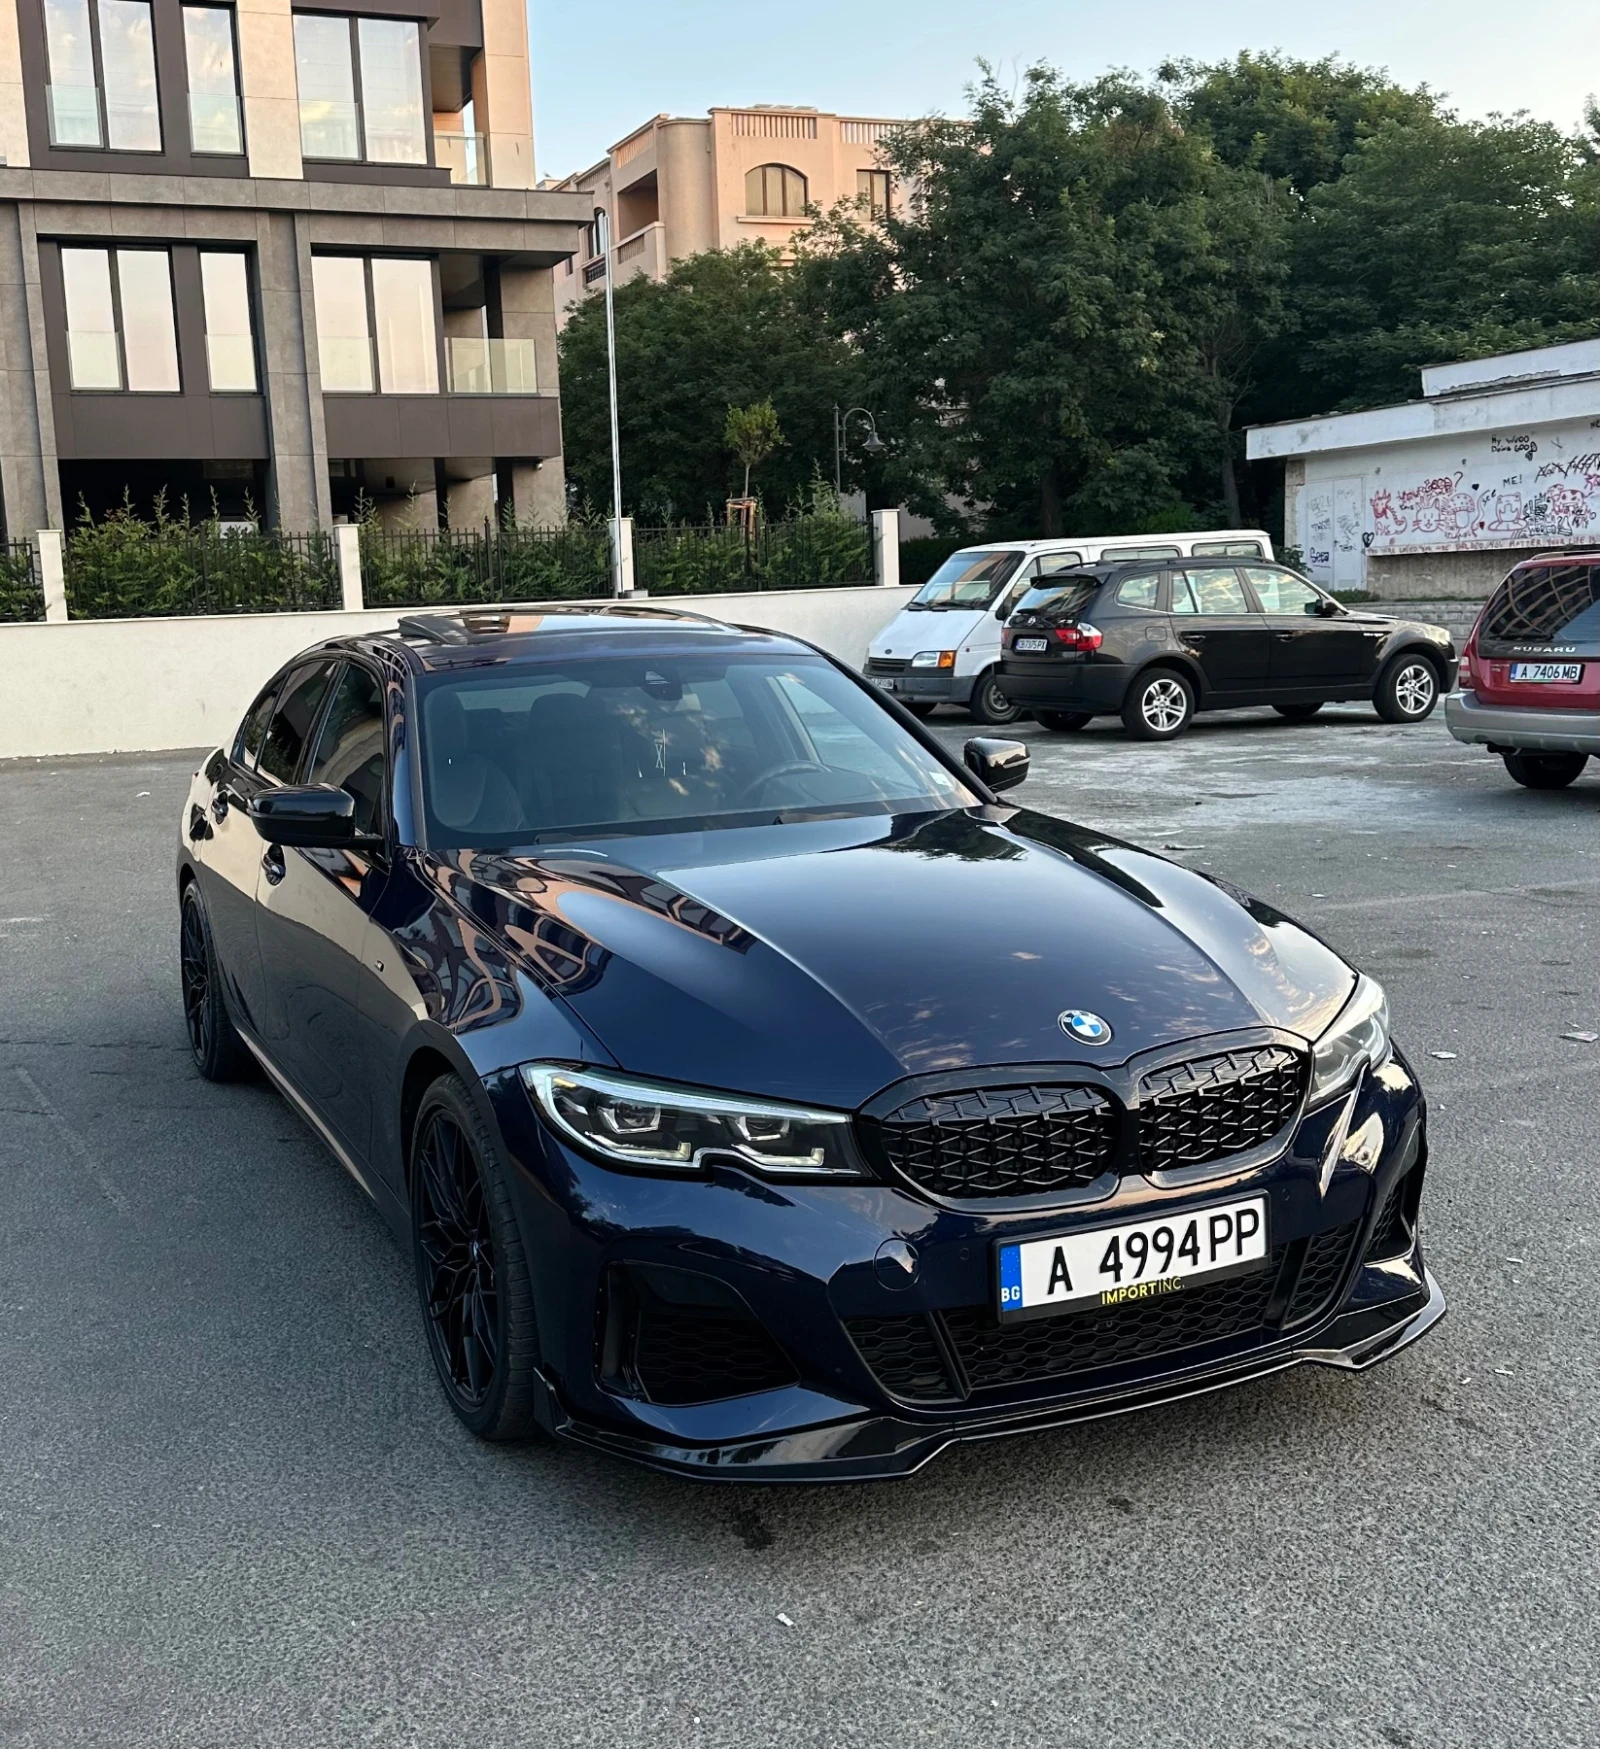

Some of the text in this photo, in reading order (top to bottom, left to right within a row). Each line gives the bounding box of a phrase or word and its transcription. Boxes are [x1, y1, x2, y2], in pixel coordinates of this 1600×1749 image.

[1503, 474, 1522, 488] ME!
[1520, 666, 1577, 679] A 7406 MB
[1048, 1208, 1259, 1295] A 4994 PP
[1001, 1286, 1021, 1303] BG
